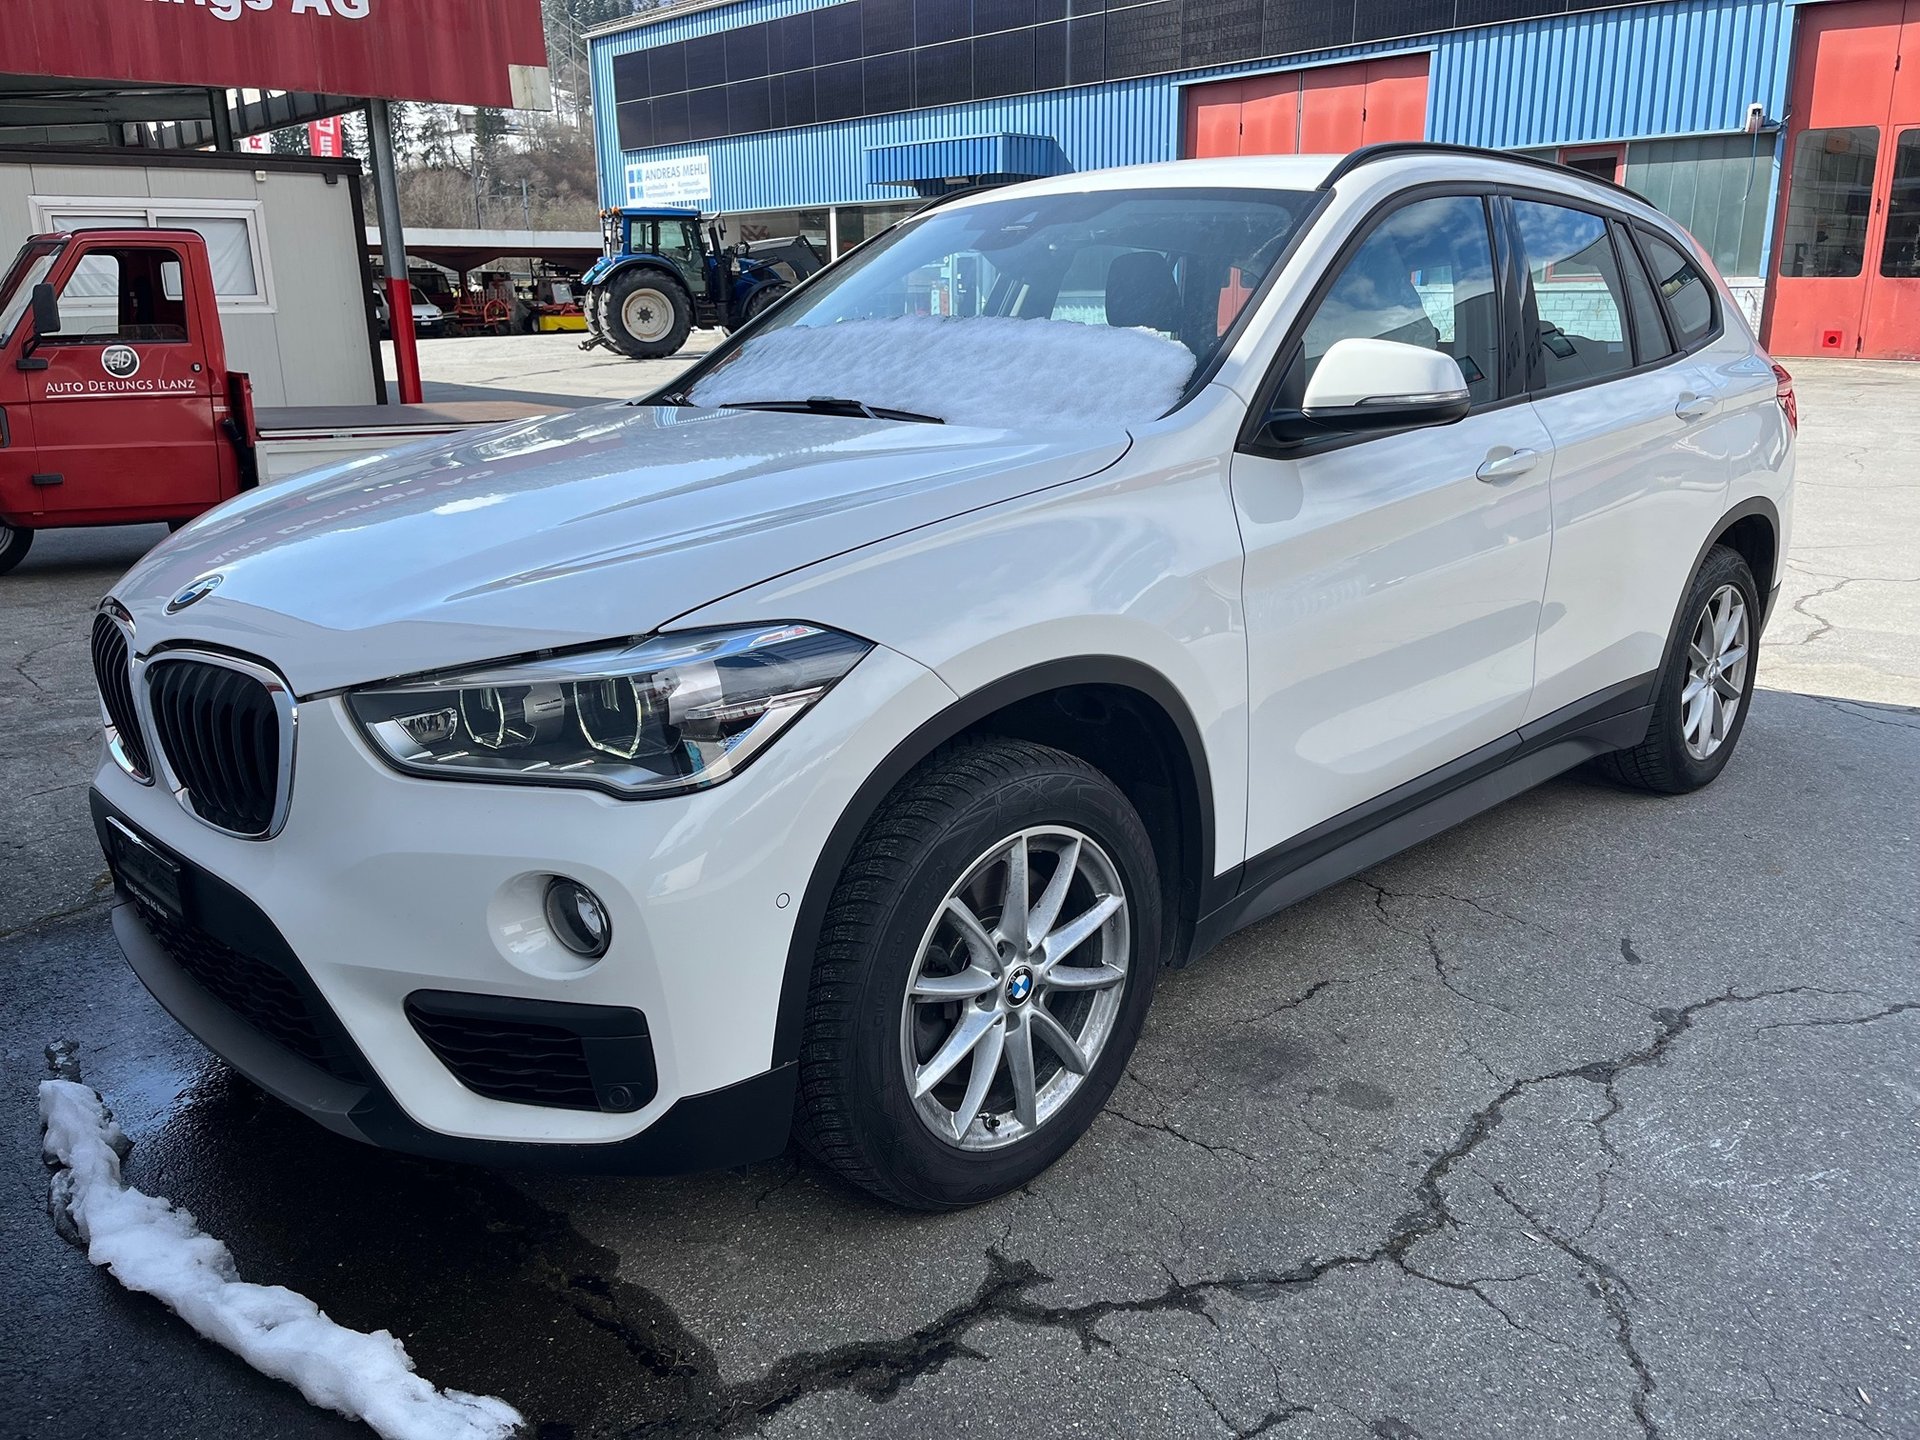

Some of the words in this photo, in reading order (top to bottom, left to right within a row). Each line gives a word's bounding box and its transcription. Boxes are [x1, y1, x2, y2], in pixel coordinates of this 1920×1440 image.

[645, 166, 681, 180] ANDREAS
[682, 162, 707, 177] MEHLI
[45, 382, 84, 393] AUTO
[88, 379, 153, 392] DERUNGS
[158, 378, 196, 390] ILANZ
